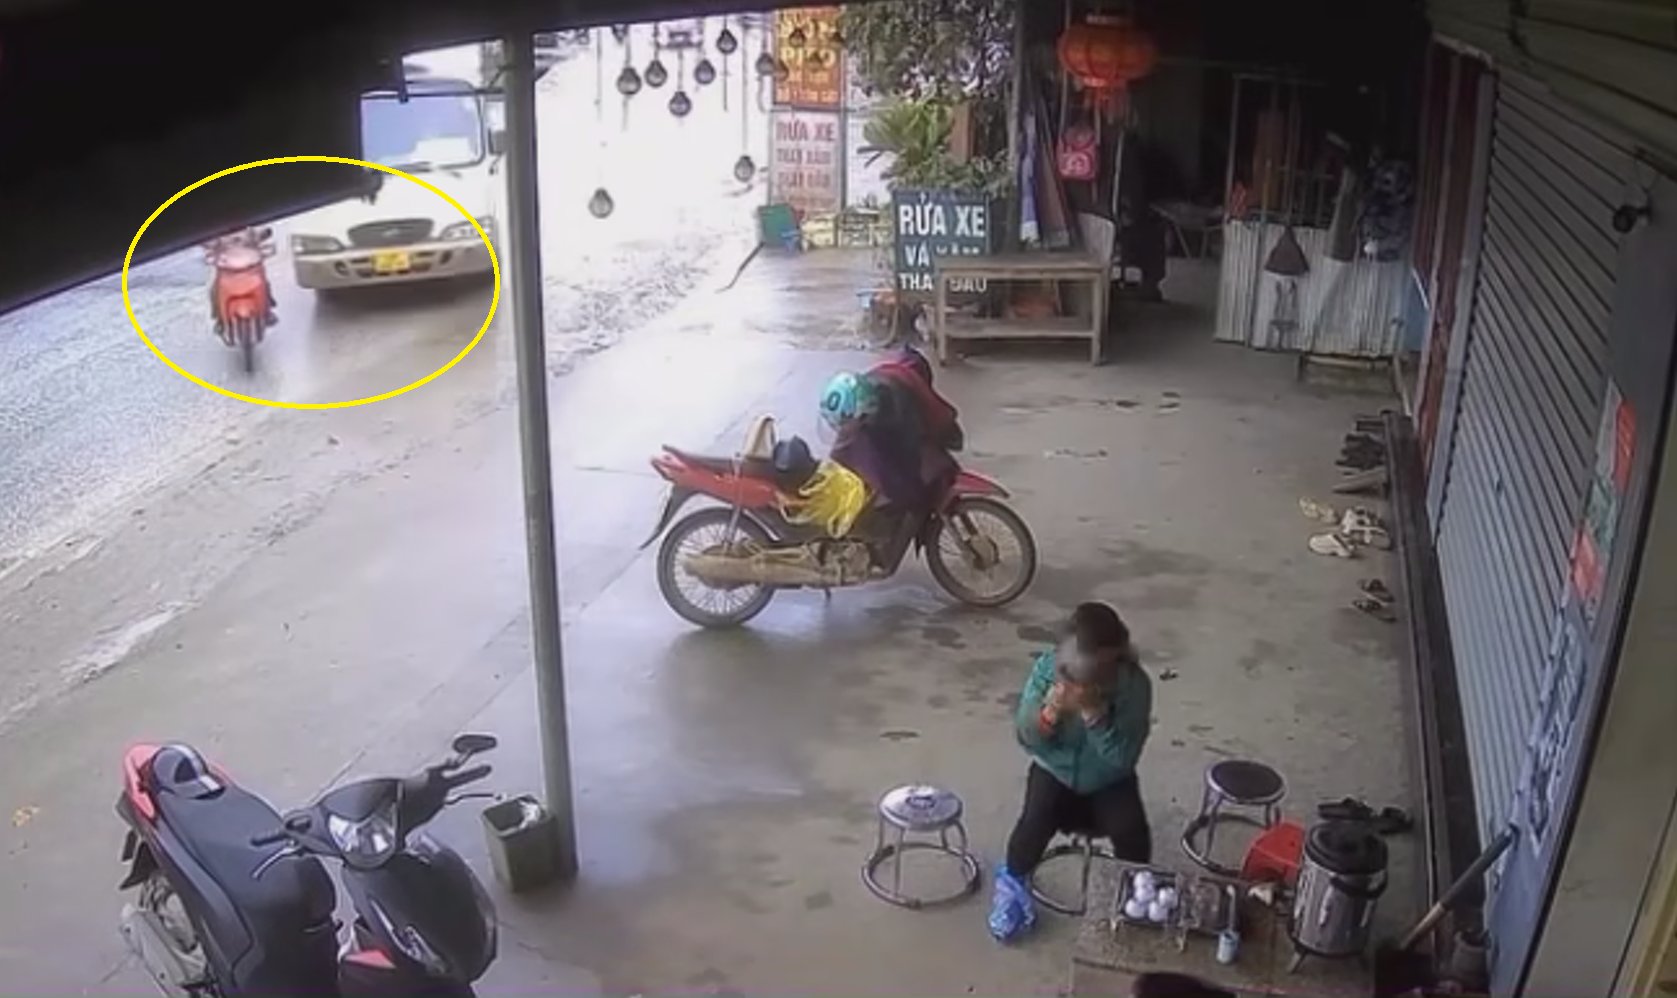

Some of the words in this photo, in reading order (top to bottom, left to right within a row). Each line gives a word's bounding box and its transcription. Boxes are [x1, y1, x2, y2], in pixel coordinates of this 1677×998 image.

[814, 122, 835, 141] XE
[899, 193, 947, 236] RỬA
[955, 204, 985, 237] XE
[898, 272, 934, 291] THA
